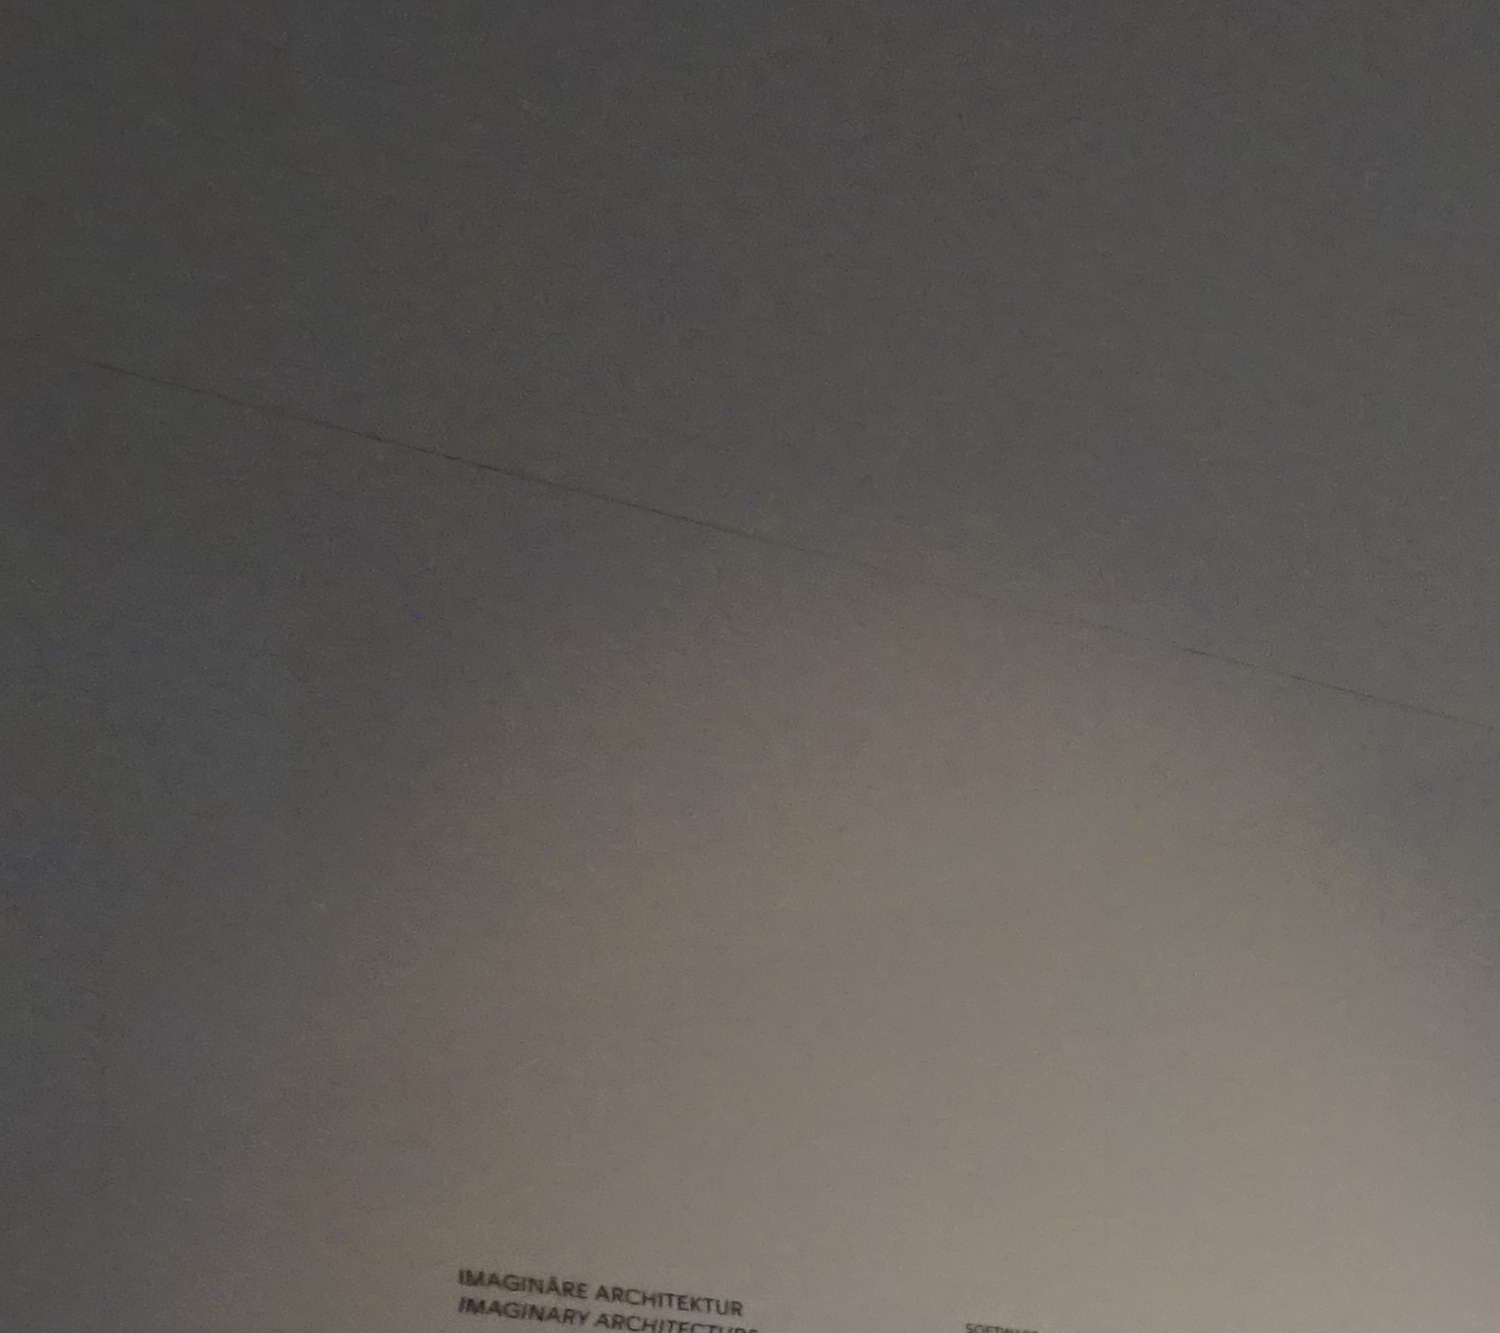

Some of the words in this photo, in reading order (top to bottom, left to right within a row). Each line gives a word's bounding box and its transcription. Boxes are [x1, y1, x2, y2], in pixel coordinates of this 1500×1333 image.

[457, 1268, 589, 1300] IMAGINÄRE
[594, 1284, 743, 1317] ARCHITEKTUR
[457, 1296, 591, 1326] IMAGINARY
